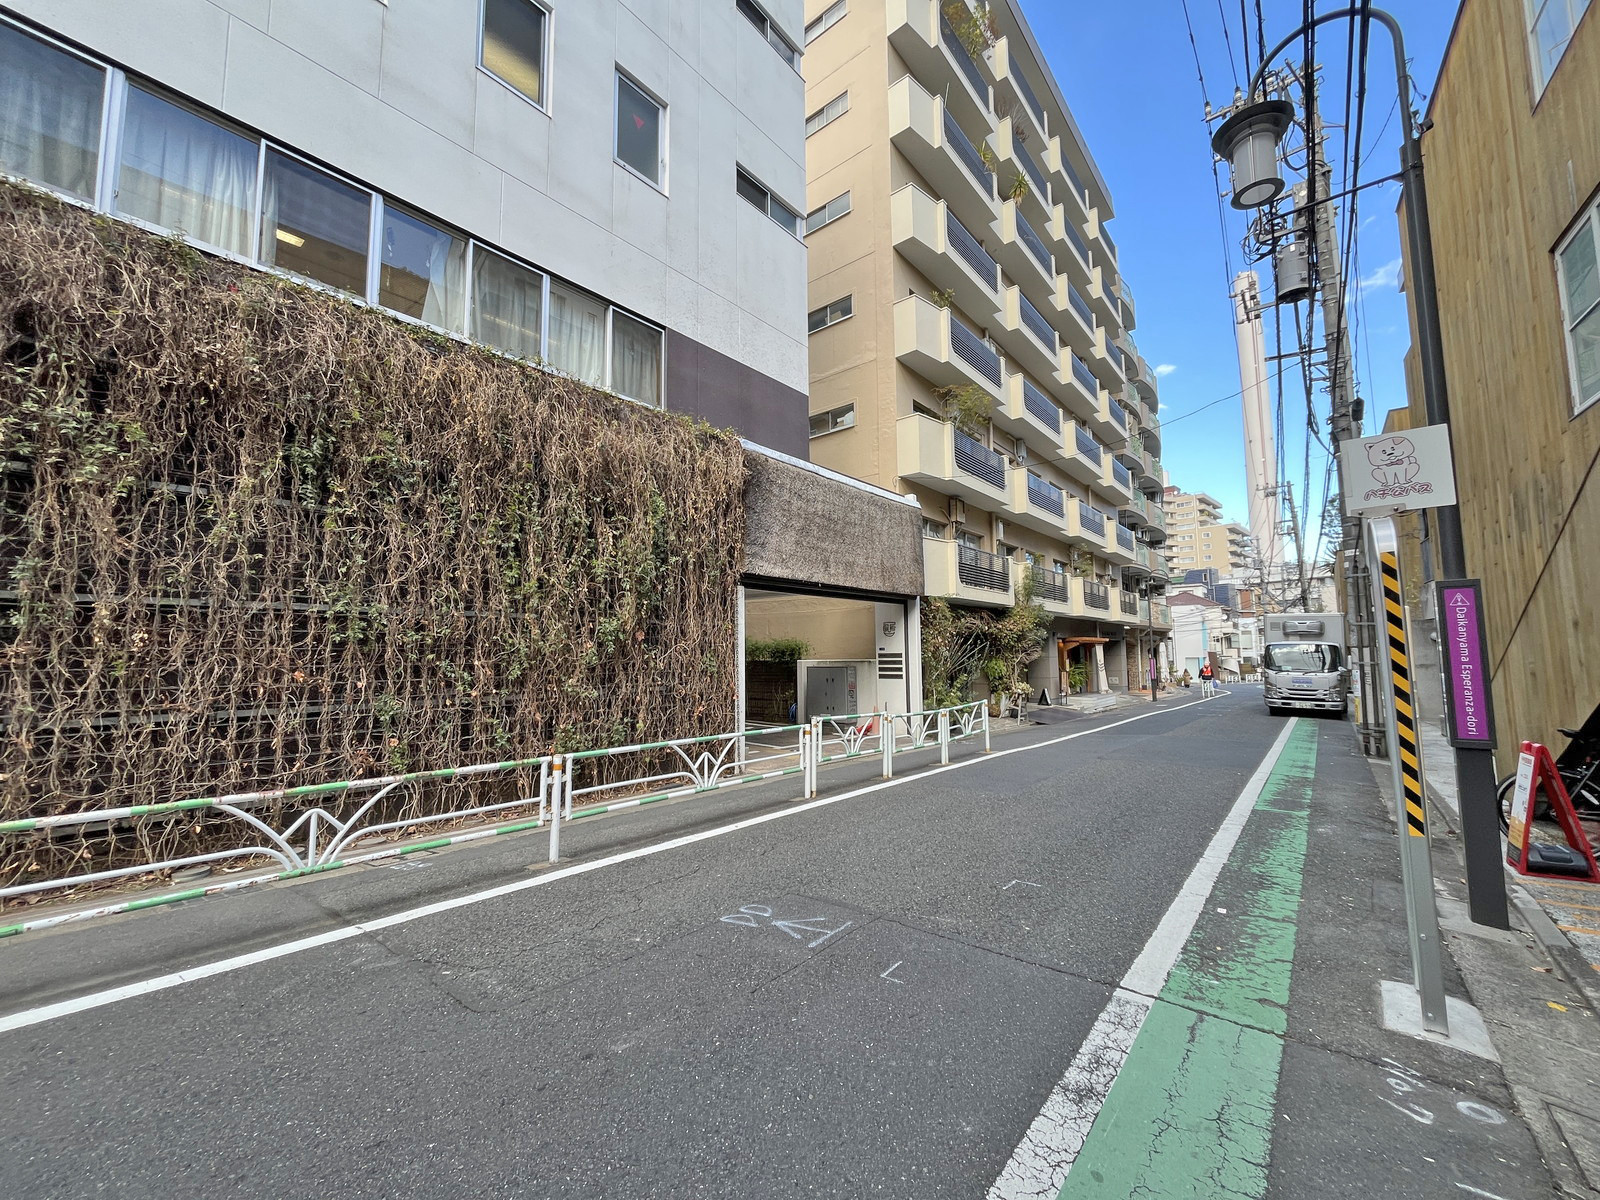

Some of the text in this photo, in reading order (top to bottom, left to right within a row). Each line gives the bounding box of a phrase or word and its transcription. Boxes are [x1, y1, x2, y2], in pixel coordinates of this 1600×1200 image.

[1364, 482, 1433, 501] ハチ公バス
[1456, 607, 1470, 662] Daikanyama
